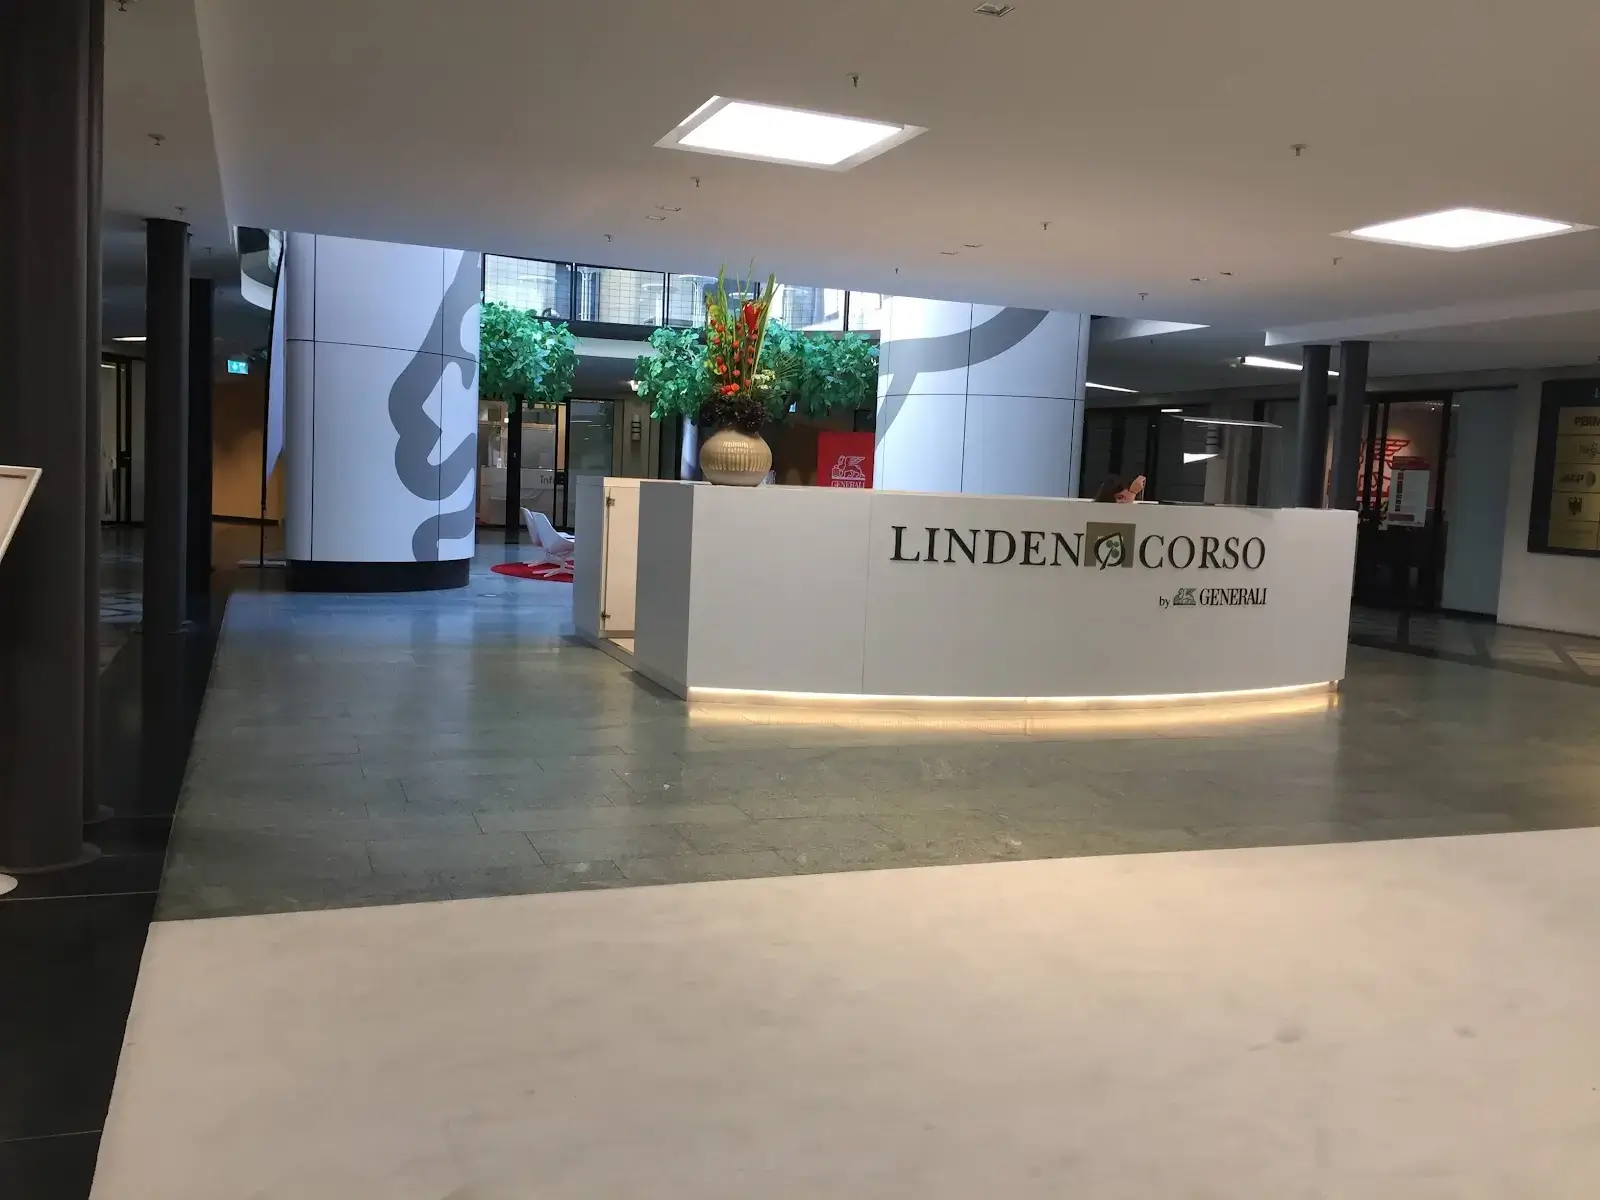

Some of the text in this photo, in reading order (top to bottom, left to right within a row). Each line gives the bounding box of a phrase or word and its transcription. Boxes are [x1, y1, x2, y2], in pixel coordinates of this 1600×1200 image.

[890, 525, 1266, 570] LINDEN CORSO
[1159, 587, 1268, 609] by GENERALI
